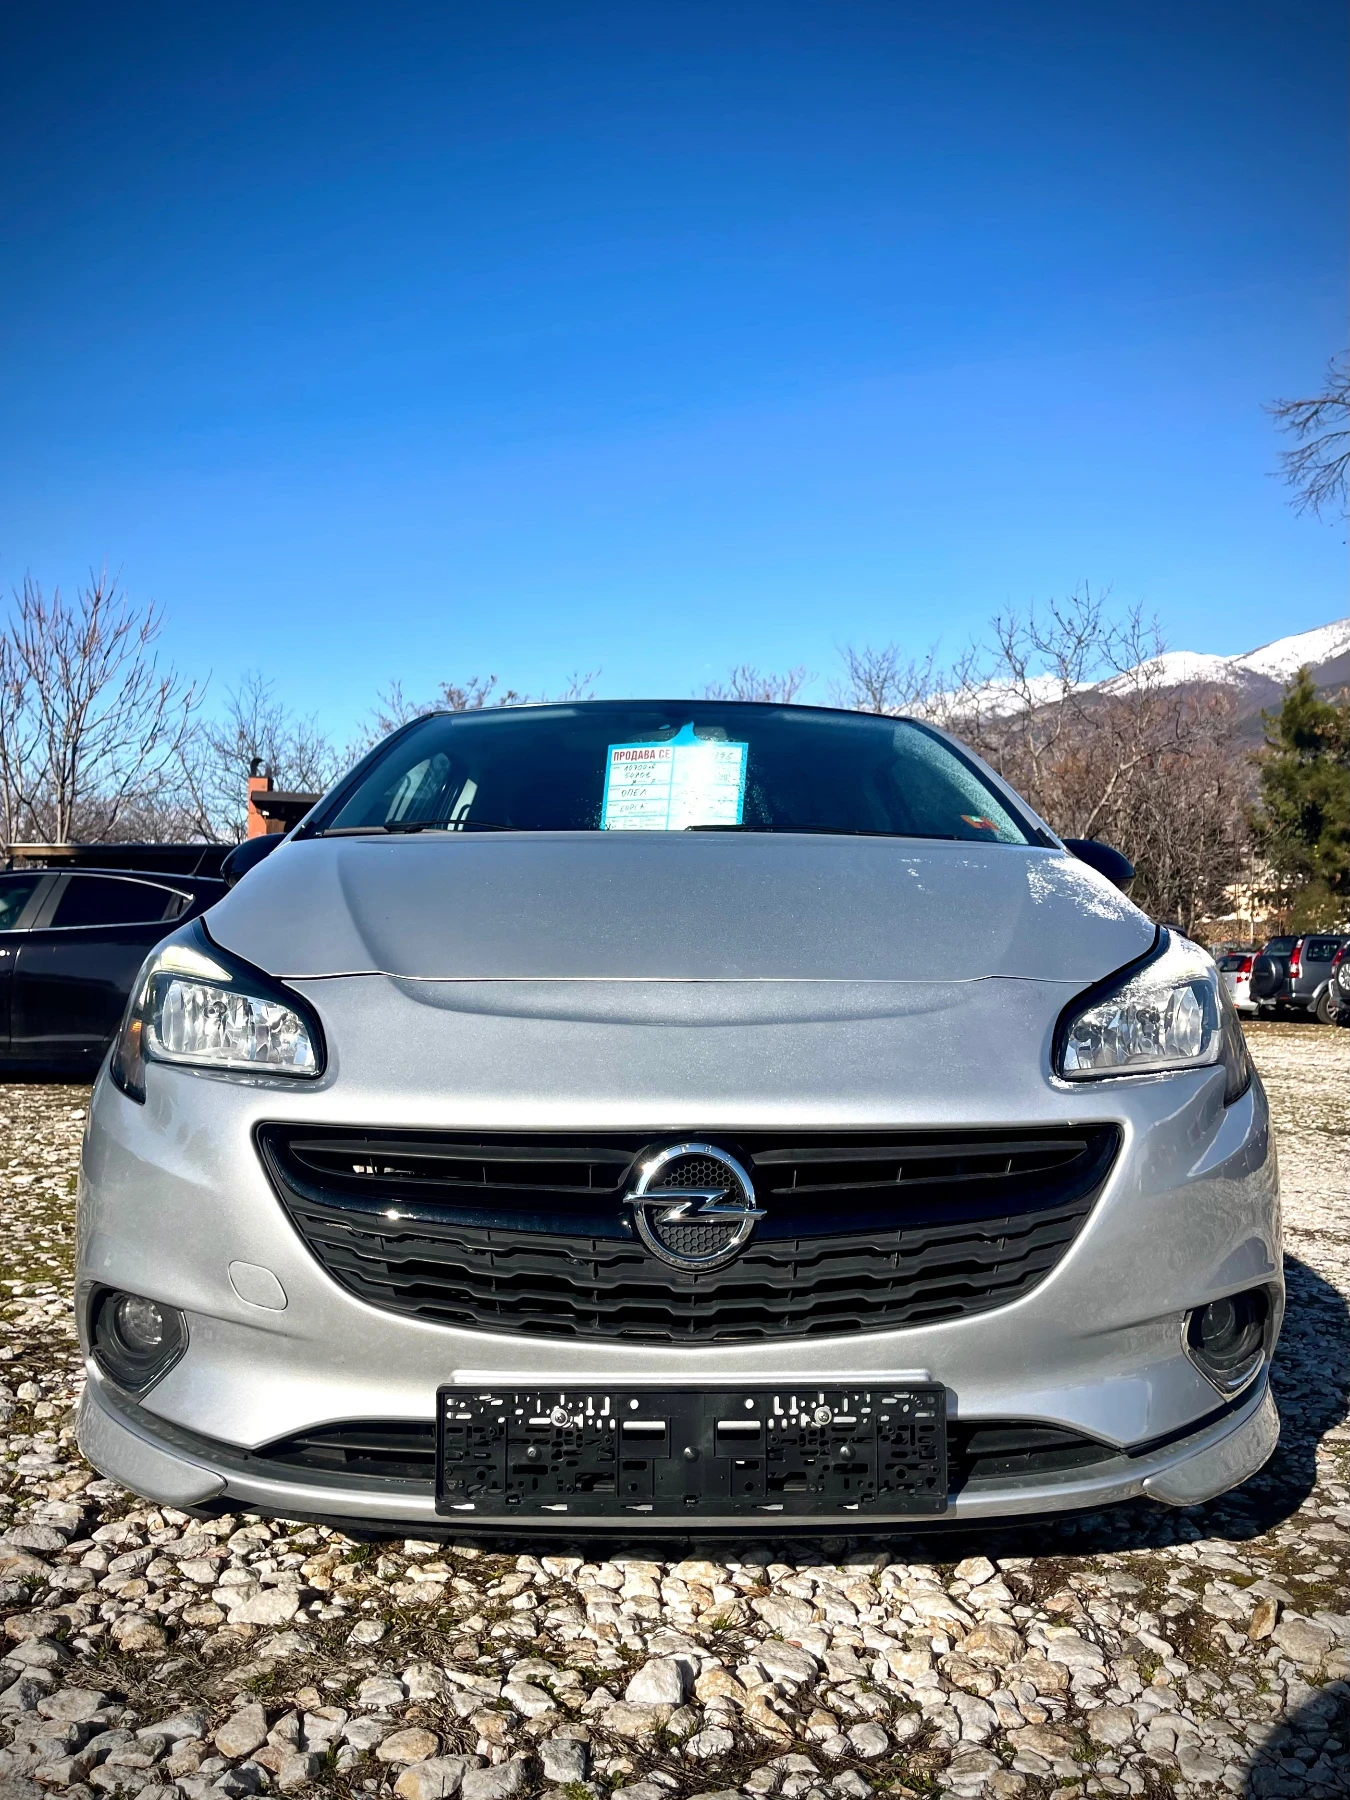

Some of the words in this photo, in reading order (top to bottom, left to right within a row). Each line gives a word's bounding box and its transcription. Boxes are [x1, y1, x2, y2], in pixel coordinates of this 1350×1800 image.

[613, 750, 656, 761] ПРОДАВА
[659, 749, 671, 759] СЕ
[621, 788, 647, 797] ОПЕЛ
